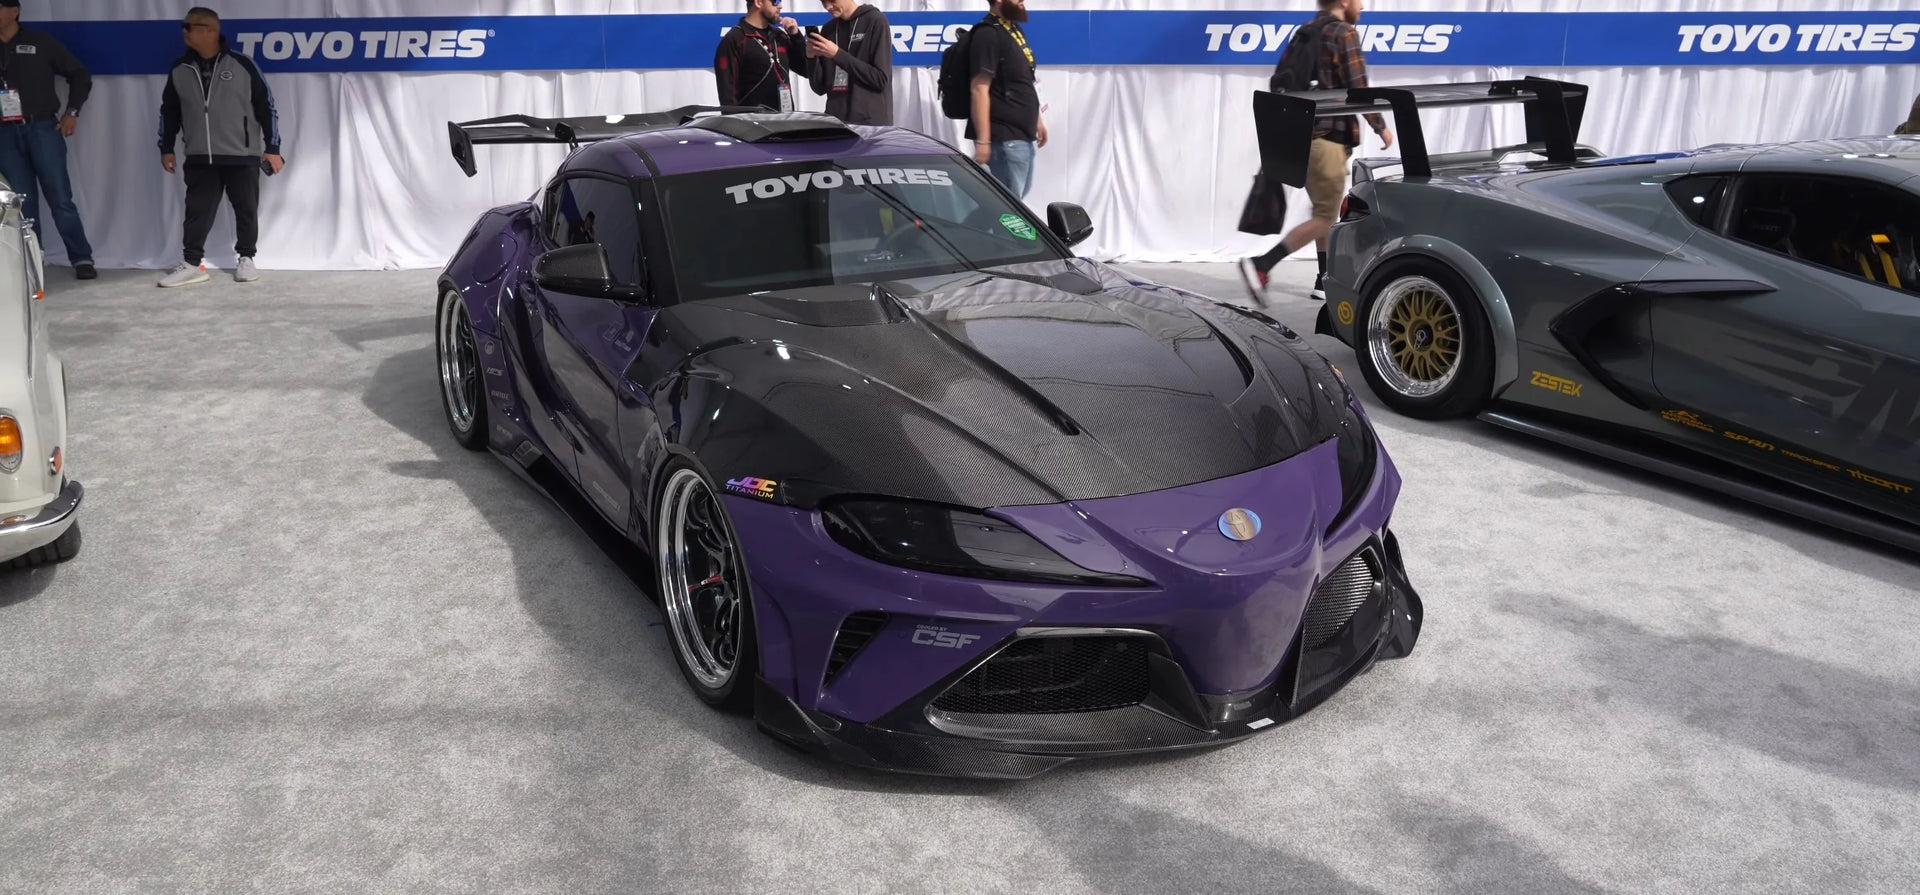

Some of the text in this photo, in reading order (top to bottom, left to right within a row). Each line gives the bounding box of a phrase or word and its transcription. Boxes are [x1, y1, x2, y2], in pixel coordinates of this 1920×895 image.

[236, 31, 354, 60] TOYO
[889, 24, 974, 52] RES
[1205, 24, 1301, 52] TOY
[1678, 23, 1920, 53] TOYO TIRES
[725, 168, 953, 204] TOYO TIRES
[1530, 370, 1584, 398] ZESTEK
[726, 484, 774, 499] TITANIUM
[911, 629, 981, 649] CSF
